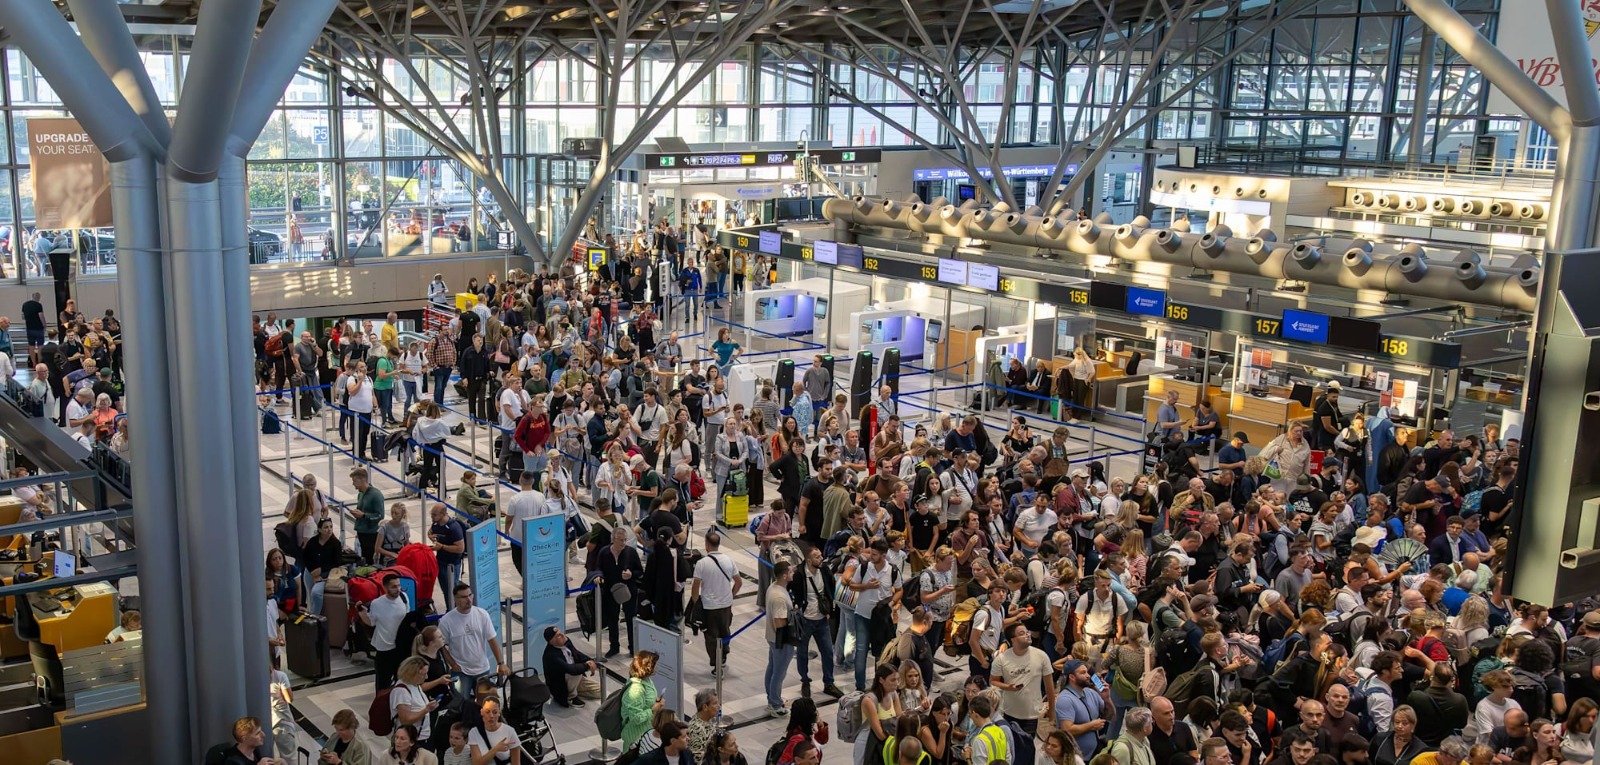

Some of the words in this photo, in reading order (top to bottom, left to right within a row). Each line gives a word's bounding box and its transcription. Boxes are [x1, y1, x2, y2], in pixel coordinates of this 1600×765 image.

[35, 133, 89, 143] UPGRADE
[314, 128, 327, 140] P5
[36, 144, 65, 155] YOUR
[67, 144, 96, 155] SEAT.
[947, 169, 984, 177] Willkon
[737, 236, 748, 248] 150
[801, 247, 813, 259] 151
[864, 258, 878, 270] 152
[921, 266, 937, 279] 153
[1000, 279, 1016, 292] 154
[1069, 290, 1088, 304] 155
[1167, 305, 1188, 320] 156
[1256, 319, 1279, 335] 157
[1382, 338, 1408, 356] 158
[531, 542, 560, 552] Check-in
